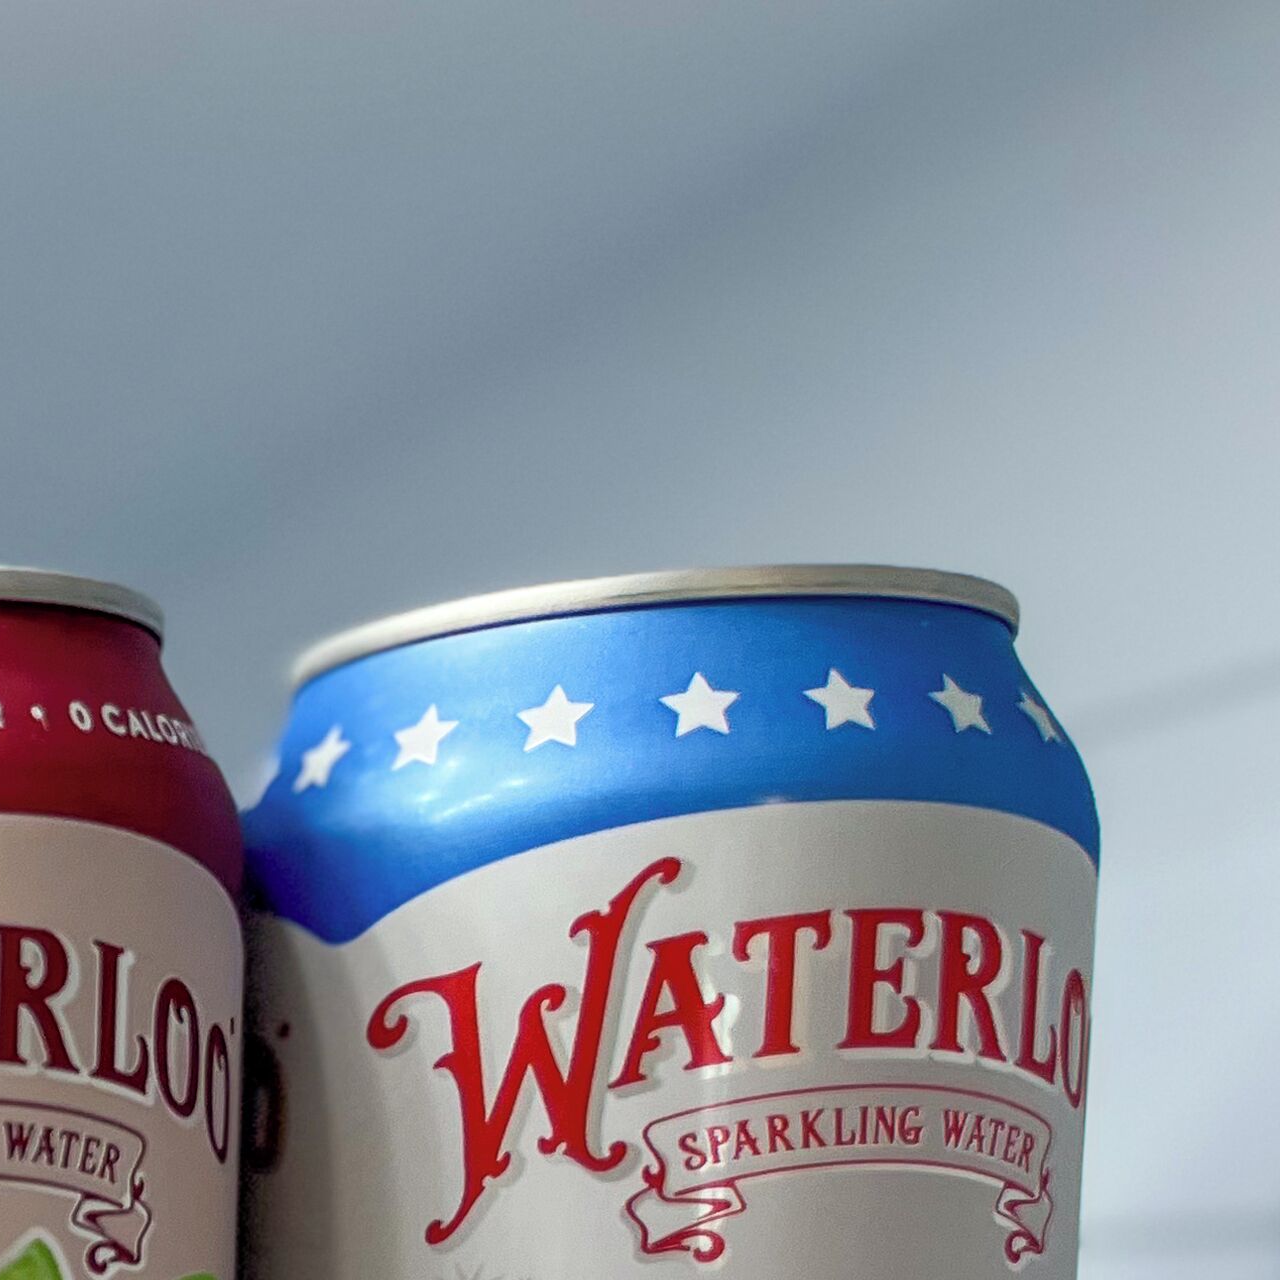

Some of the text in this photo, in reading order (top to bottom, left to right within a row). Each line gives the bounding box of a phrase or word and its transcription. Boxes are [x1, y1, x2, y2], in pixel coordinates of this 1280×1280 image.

[69, 700, 93, 732] 0
[2, 1120, 121, 1184] WATER
[678, 1105, 1036, 1175] SPARKLING WATER
